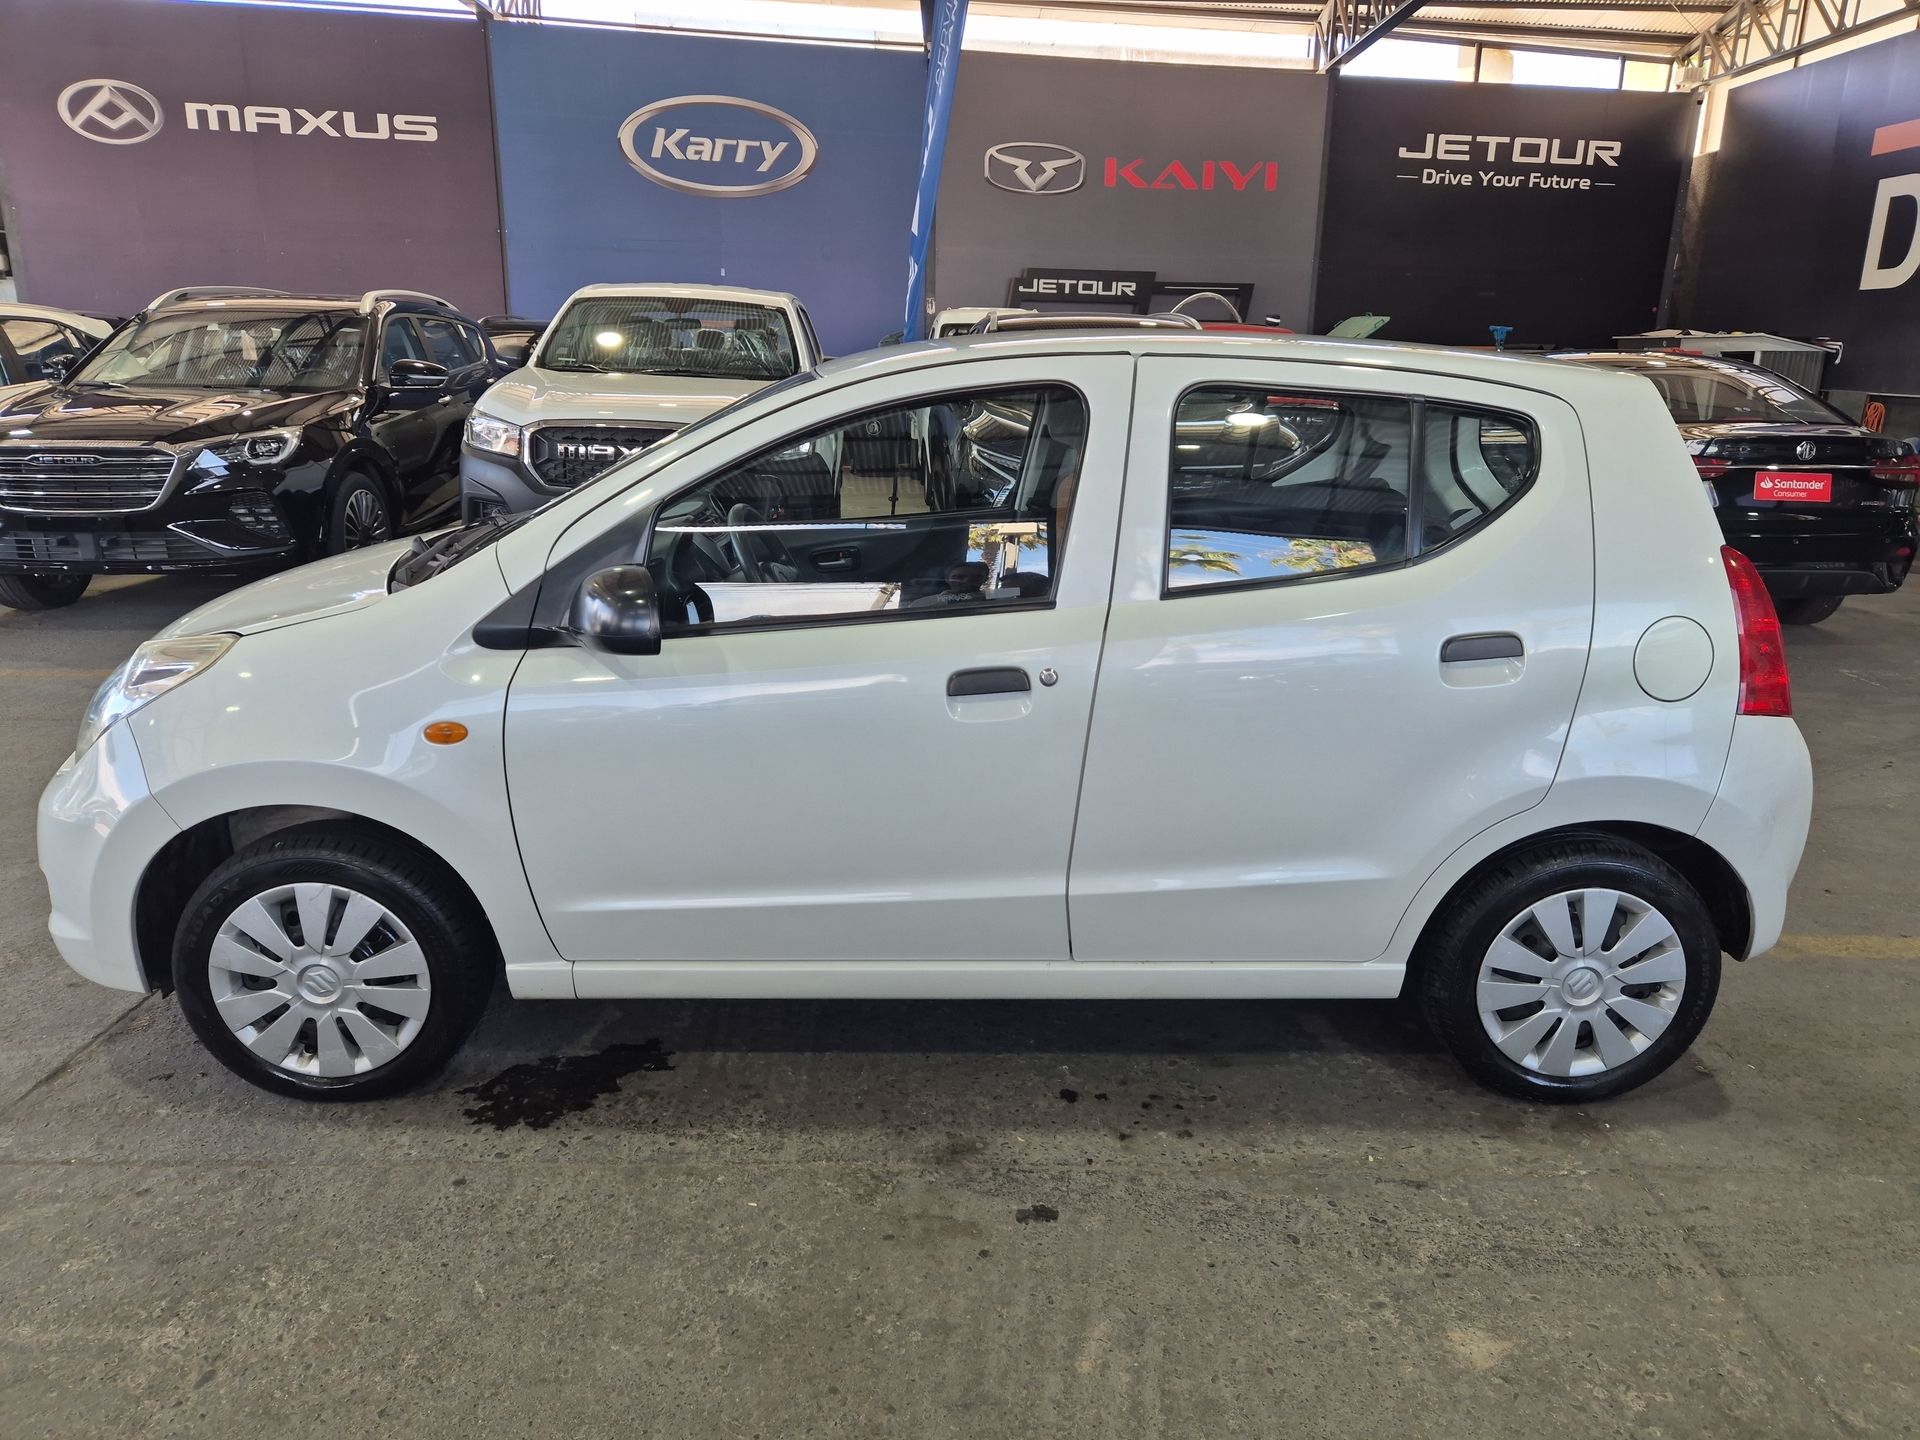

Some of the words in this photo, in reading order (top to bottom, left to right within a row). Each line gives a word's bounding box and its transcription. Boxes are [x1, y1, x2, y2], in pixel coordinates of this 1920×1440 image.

[184, 102, 438, 142] MAXUS
[651, 127, 789, 172] Karry
[1398, 133, 1621, 167] JETOUR
[1104, 156, 1278, 191] KAIYI
[1422, 168, 1472, 186] Drive
[1478, 170, 1524, 187] Your
[1529, 172, 1591, 189] Future
[1018, 278, 1136, 297] JETOUR
[34, 456, 95, 465] JETOUR
[1773, 489, 1808, 498] Consumer
[1774, 478, 1825, 490] Santander
